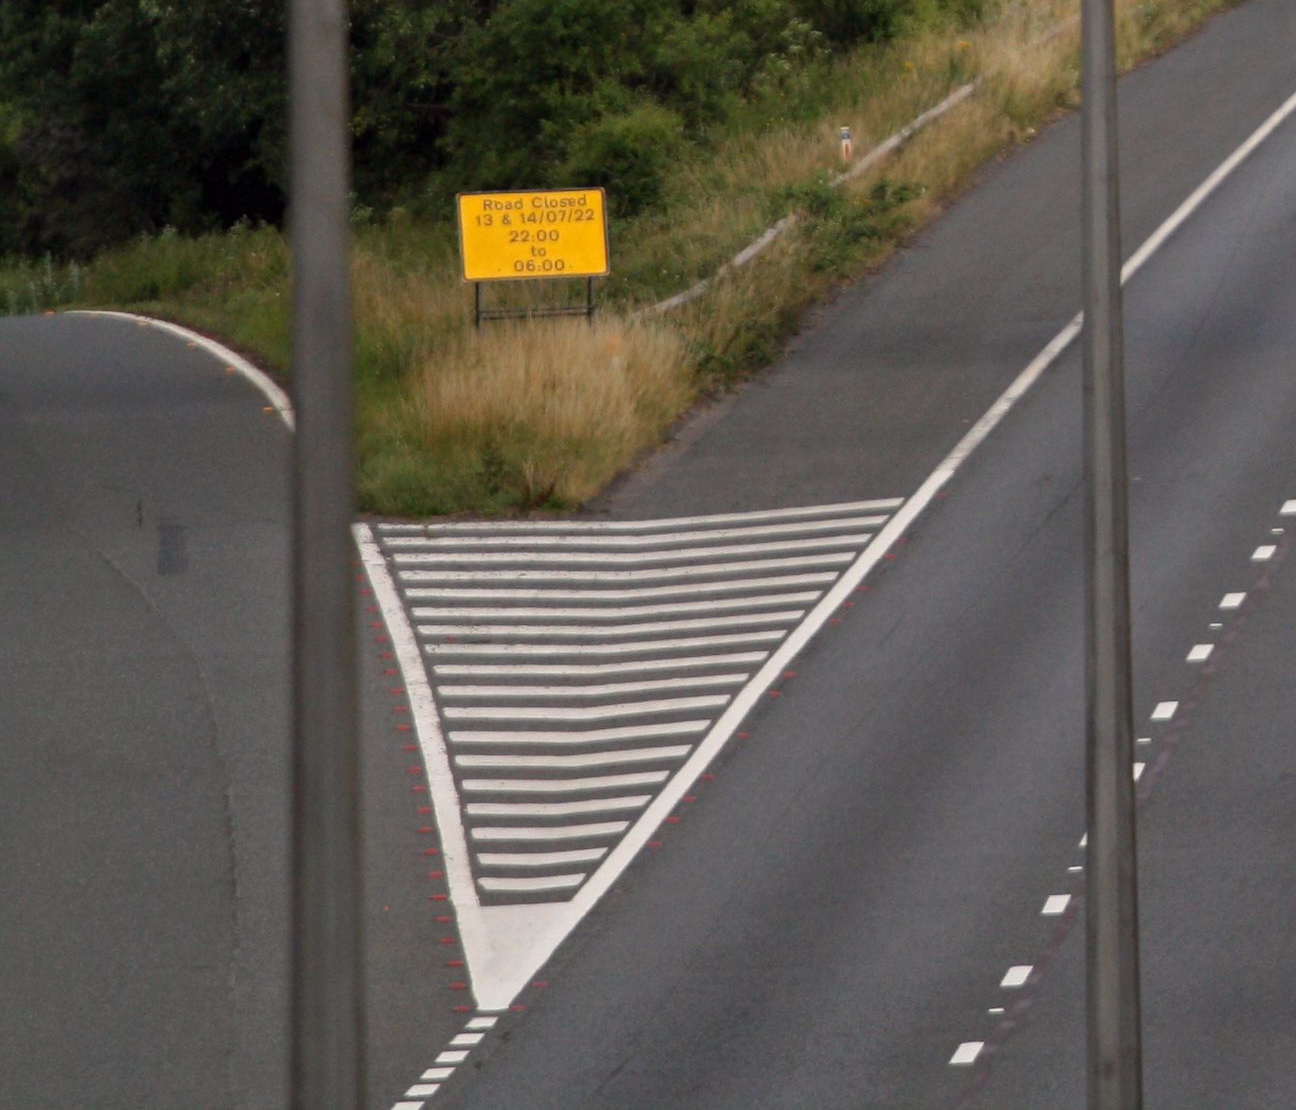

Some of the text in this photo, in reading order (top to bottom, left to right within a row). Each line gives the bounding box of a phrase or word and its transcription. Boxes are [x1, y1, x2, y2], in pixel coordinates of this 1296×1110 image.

[483, 194, 587, 211] Road Closed
[476, 208, 595, 226] 13 & 14/07/22
[509, 229, 560, 243] 22:00
[531, 245, 547, 257] to
[514, 259, 565, 272] 06:00
